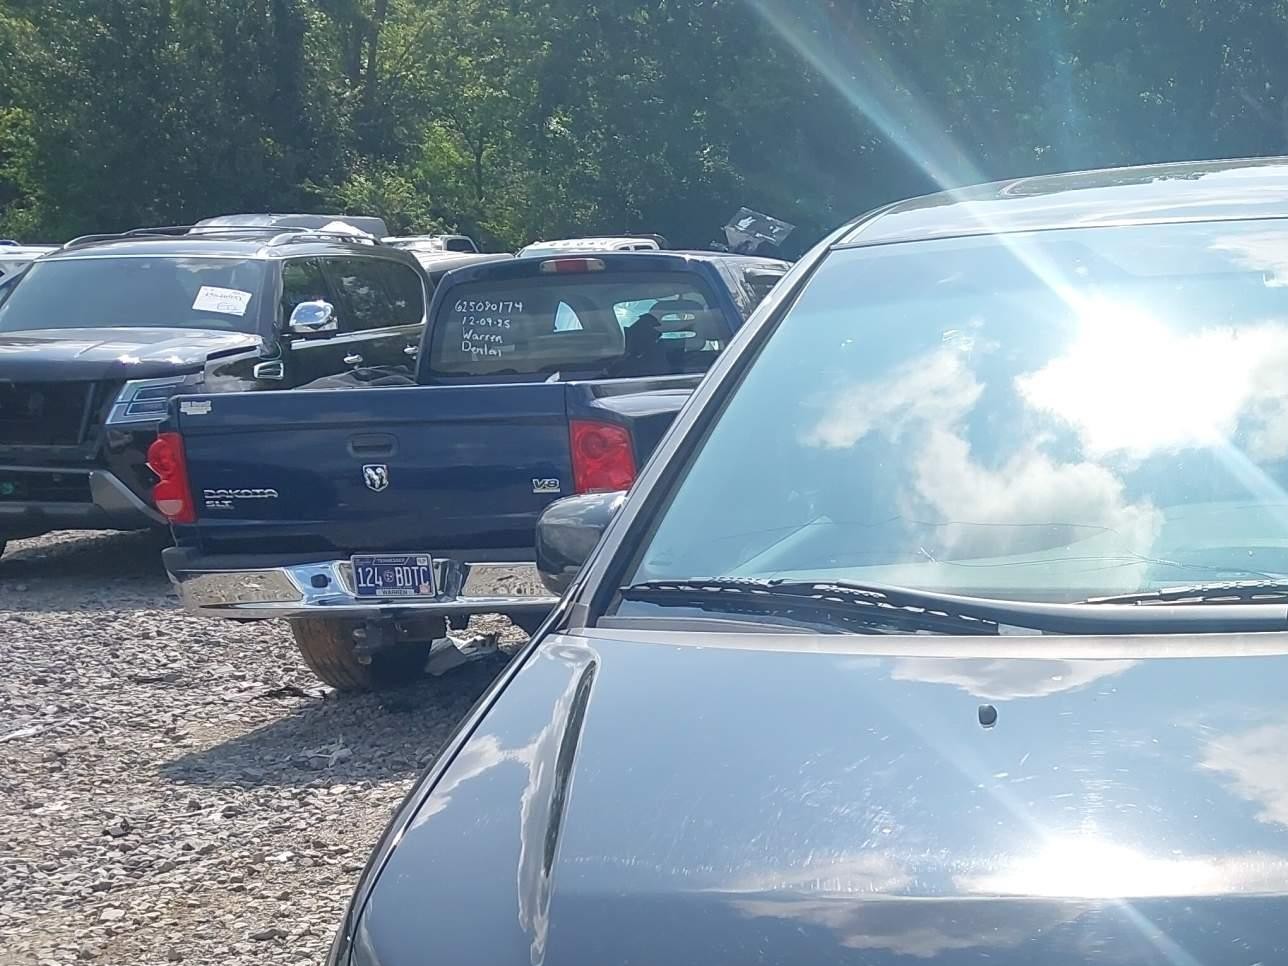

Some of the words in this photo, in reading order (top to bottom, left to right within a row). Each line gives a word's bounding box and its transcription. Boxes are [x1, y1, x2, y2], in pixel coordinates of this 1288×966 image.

[463, 327, 503, 344] Warren
[532, 478, 560, 490] V8
[203, 488, 279, 499] DAKOTA
[358, 566, 383, 587] 124
[394, 566, 429, 587] BDTC
